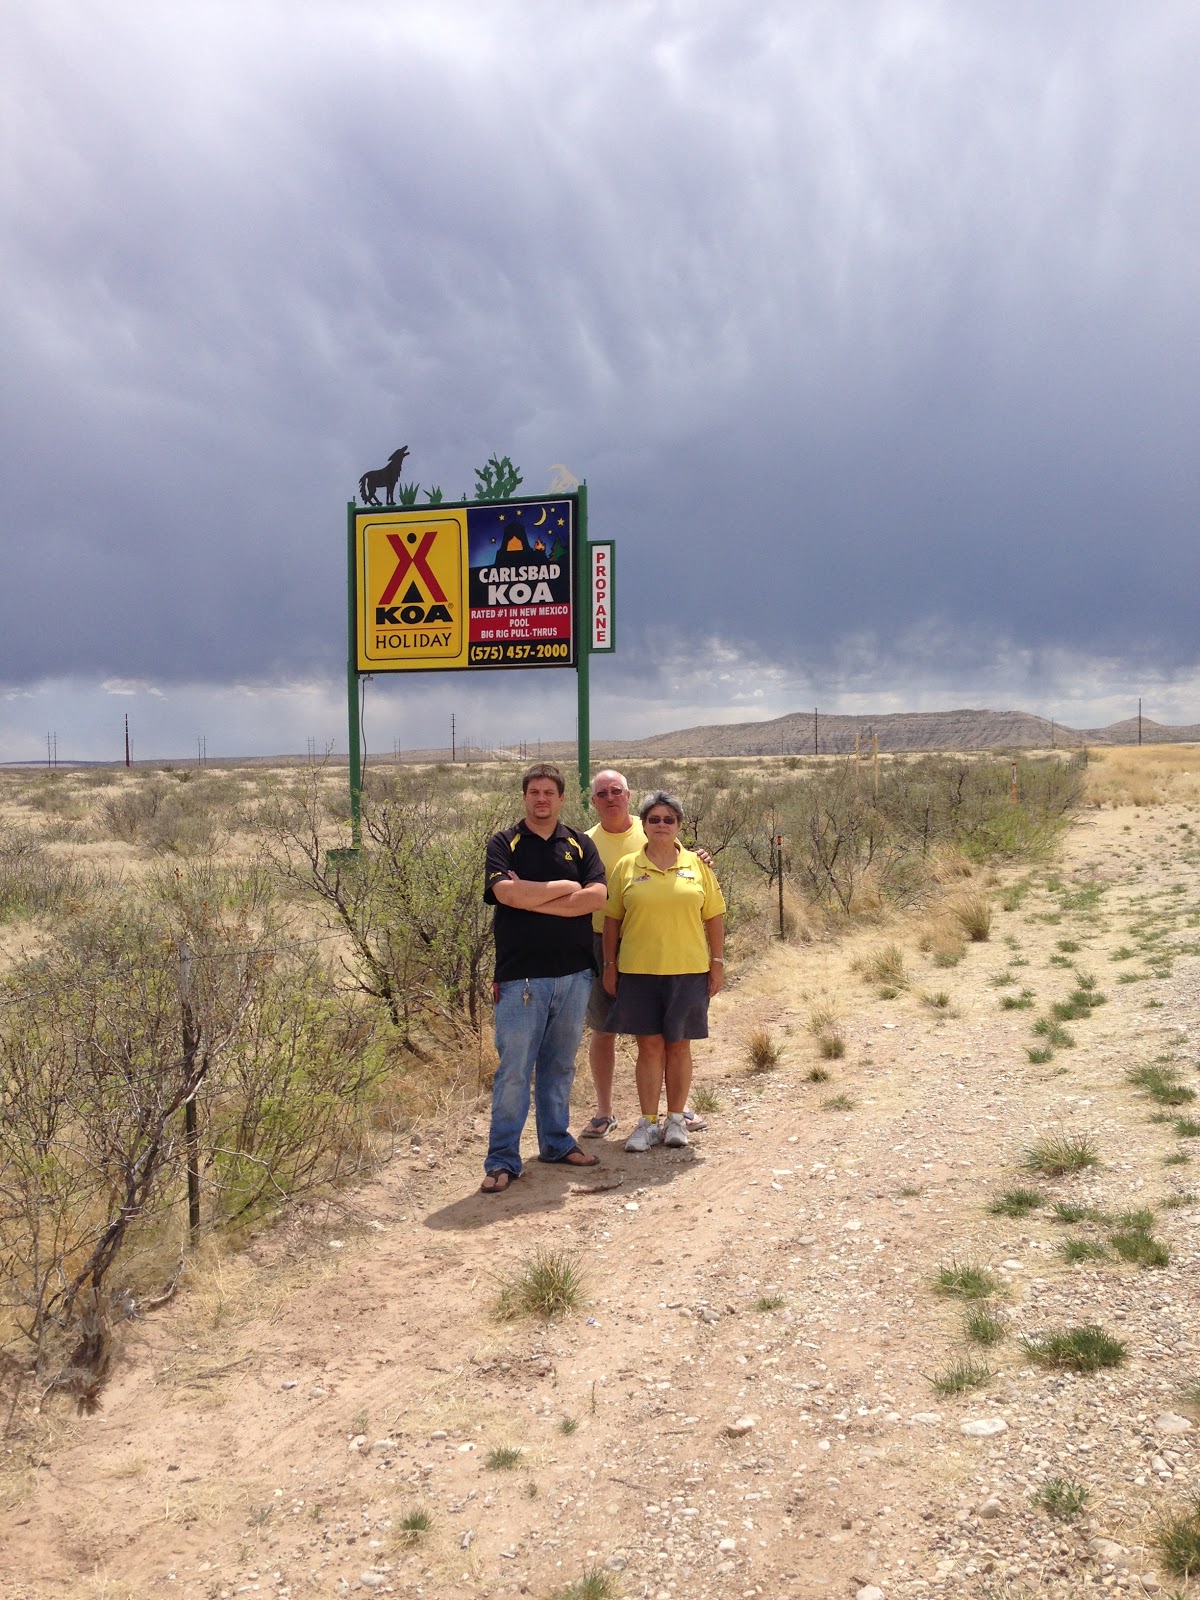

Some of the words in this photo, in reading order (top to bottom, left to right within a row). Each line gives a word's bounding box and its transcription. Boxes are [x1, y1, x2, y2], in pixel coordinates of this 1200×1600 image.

[479, 564, 561, 583] CARLSBAD
[488, 582, 554, 606] KOA
[595, 552, 607, 642] PROPANE
[375, 604, 454, 625] KOA
[471, 609, 496, 619] RATED
[497, 608, 508, 618] #1
[510, 608, 518, 617] IN
[519, 607, 537, 617] NEW
[539, 605, 568, 616] MEXICO
[509, 618, 530, 627] POOL
[375, 632, 452, 649] HOLIDAY
[480, 630, 494, 639] BIG
[495, 629, 509, 638] RIG
[511, 627, 558, 637] PULL-THRUS
[470, 645, 504, 661] (575)
[506, 643, 568, 659] 457-2000
